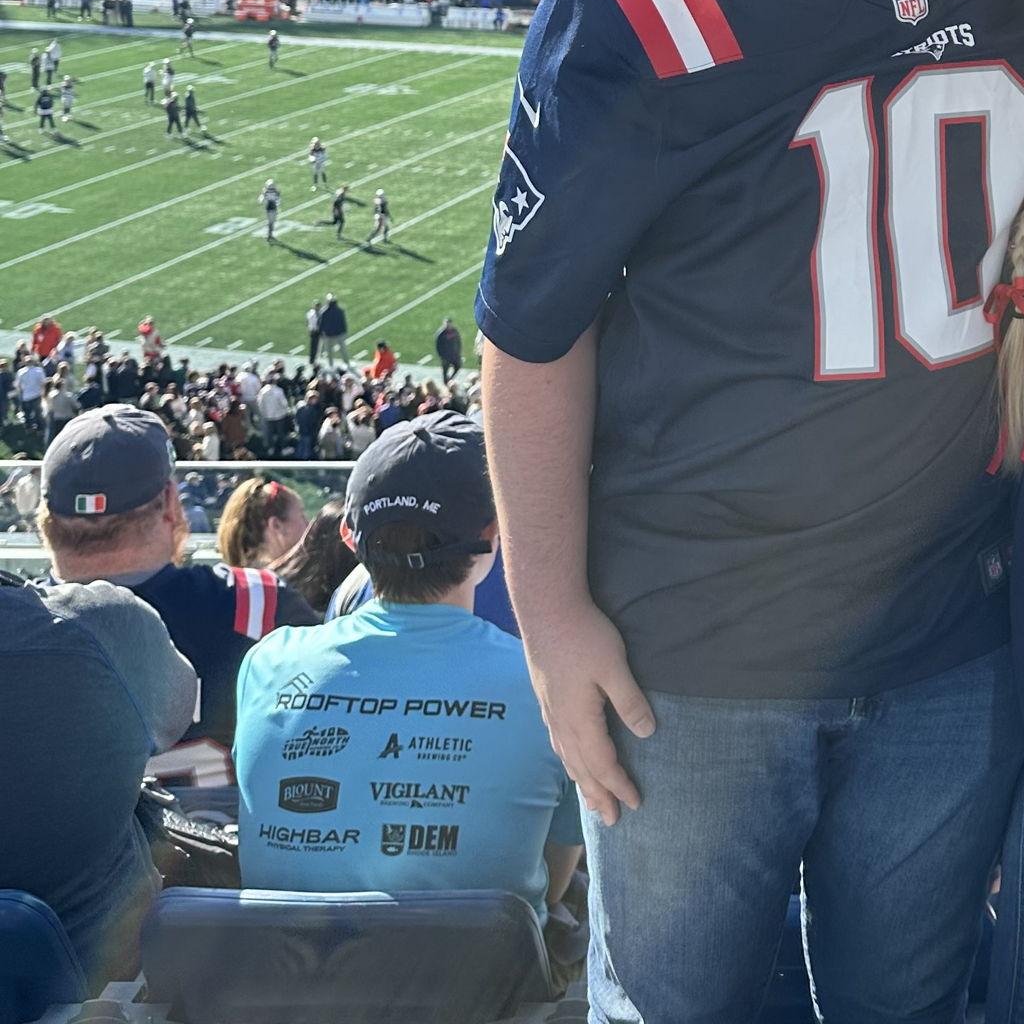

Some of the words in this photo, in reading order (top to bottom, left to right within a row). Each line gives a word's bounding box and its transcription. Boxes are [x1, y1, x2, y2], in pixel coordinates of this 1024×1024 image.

[363, 496, 418, 516] PORTLAND,
[422, 499, 441, 515] ME
[276, 692, 397, 716] ROOFTOP
[403, 698, 507, 720] POWER
[408, 736, 472, 752] ATHLETIC
[284, 782, 334, 801] BLOUNT
[370, 781, 471, 805] VIGILANT
[259, 823, 360, 844] HIGHBAR
[408, 824, 459, 850] DEM
[303, 845, 346, 853] THERAPY
